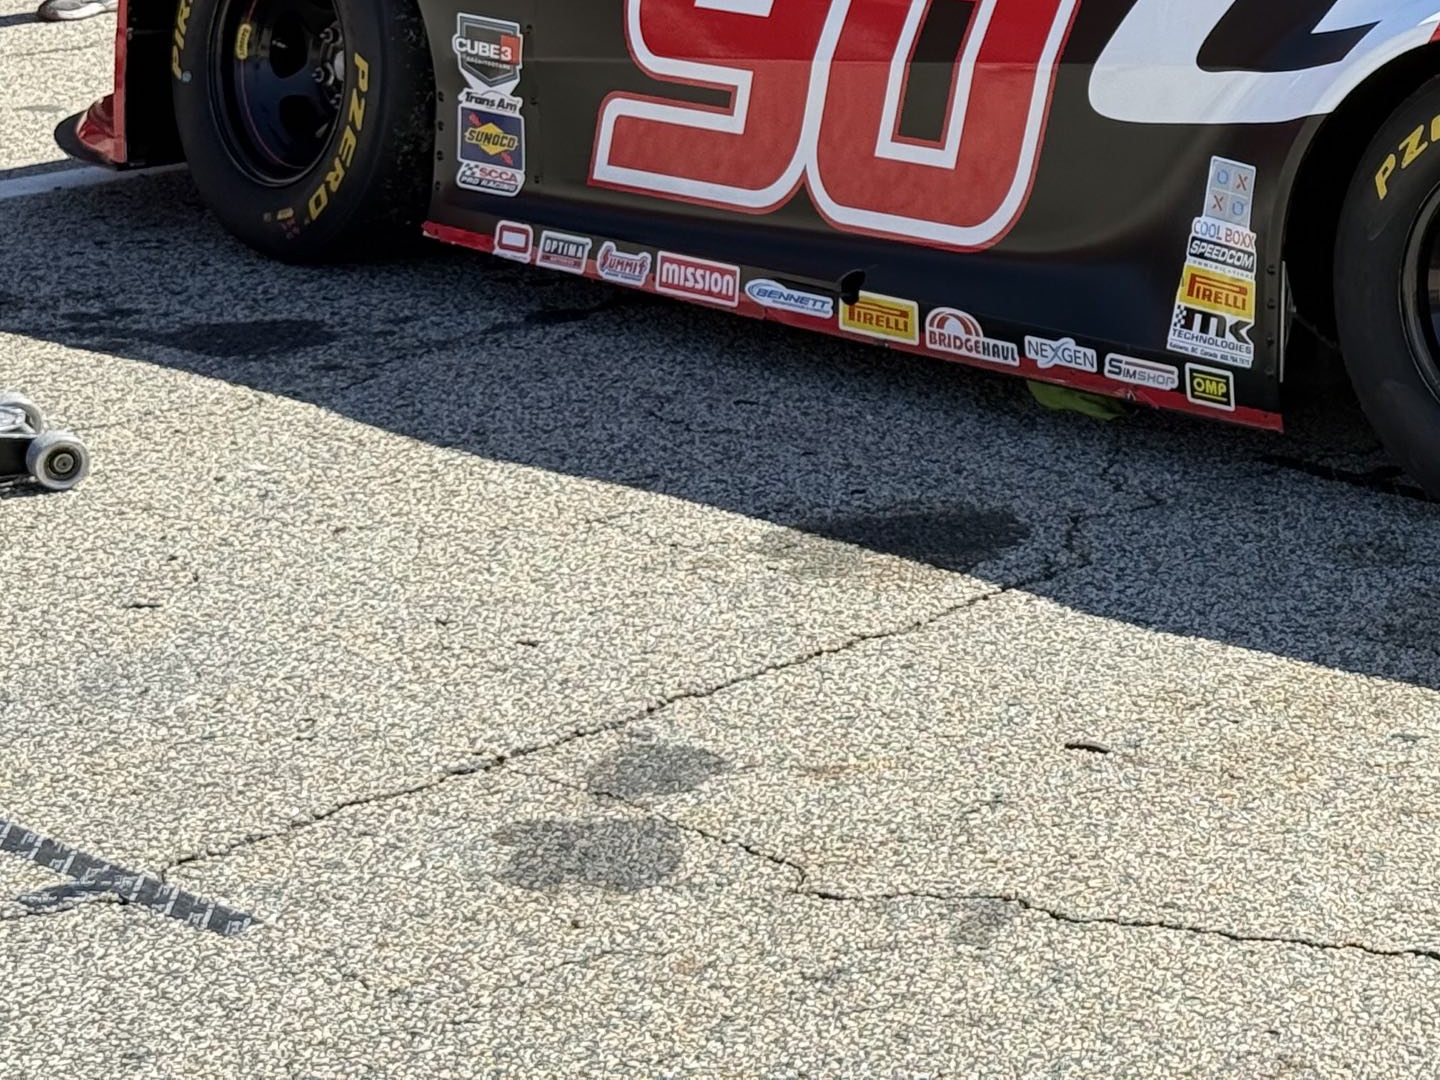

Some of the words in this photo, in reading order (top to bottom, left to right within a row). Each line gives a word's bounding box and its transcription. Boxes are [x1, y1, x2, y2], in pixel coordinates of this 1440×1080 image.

[455, 37, 513, 62] CUBE3
[465, 91, 495, 109] Trans
[496, 99, 518, 112] Am
[466, 129, 517, 150] SUNOCO
[461, 175, 479, 186] PRO
[479, 166, 518, 184] SCCA
[1193, 219, 1223, 241] COOL
[1224, 227, 1255, 250] BOXX
[545, 238, 584, 259] OPTIMA
[601, 245, 648, 276] SUMMIT
[1189, 238, 1254, 269] SPEEDCOM
[756, 287, 830, 311] BENNETT
[1186, 273, 1248, 311] PIRELLI
[928, 330, 1018, 362] BRIDGEHAUL
[1027, 338, 1095, 368] NEXGEN
[1172, 328, 1252, 355] TECHNOLOGIES
[1107, 357, 1176, 387] SIMSHOP
[1193, 376, 1228, 397] OMP
